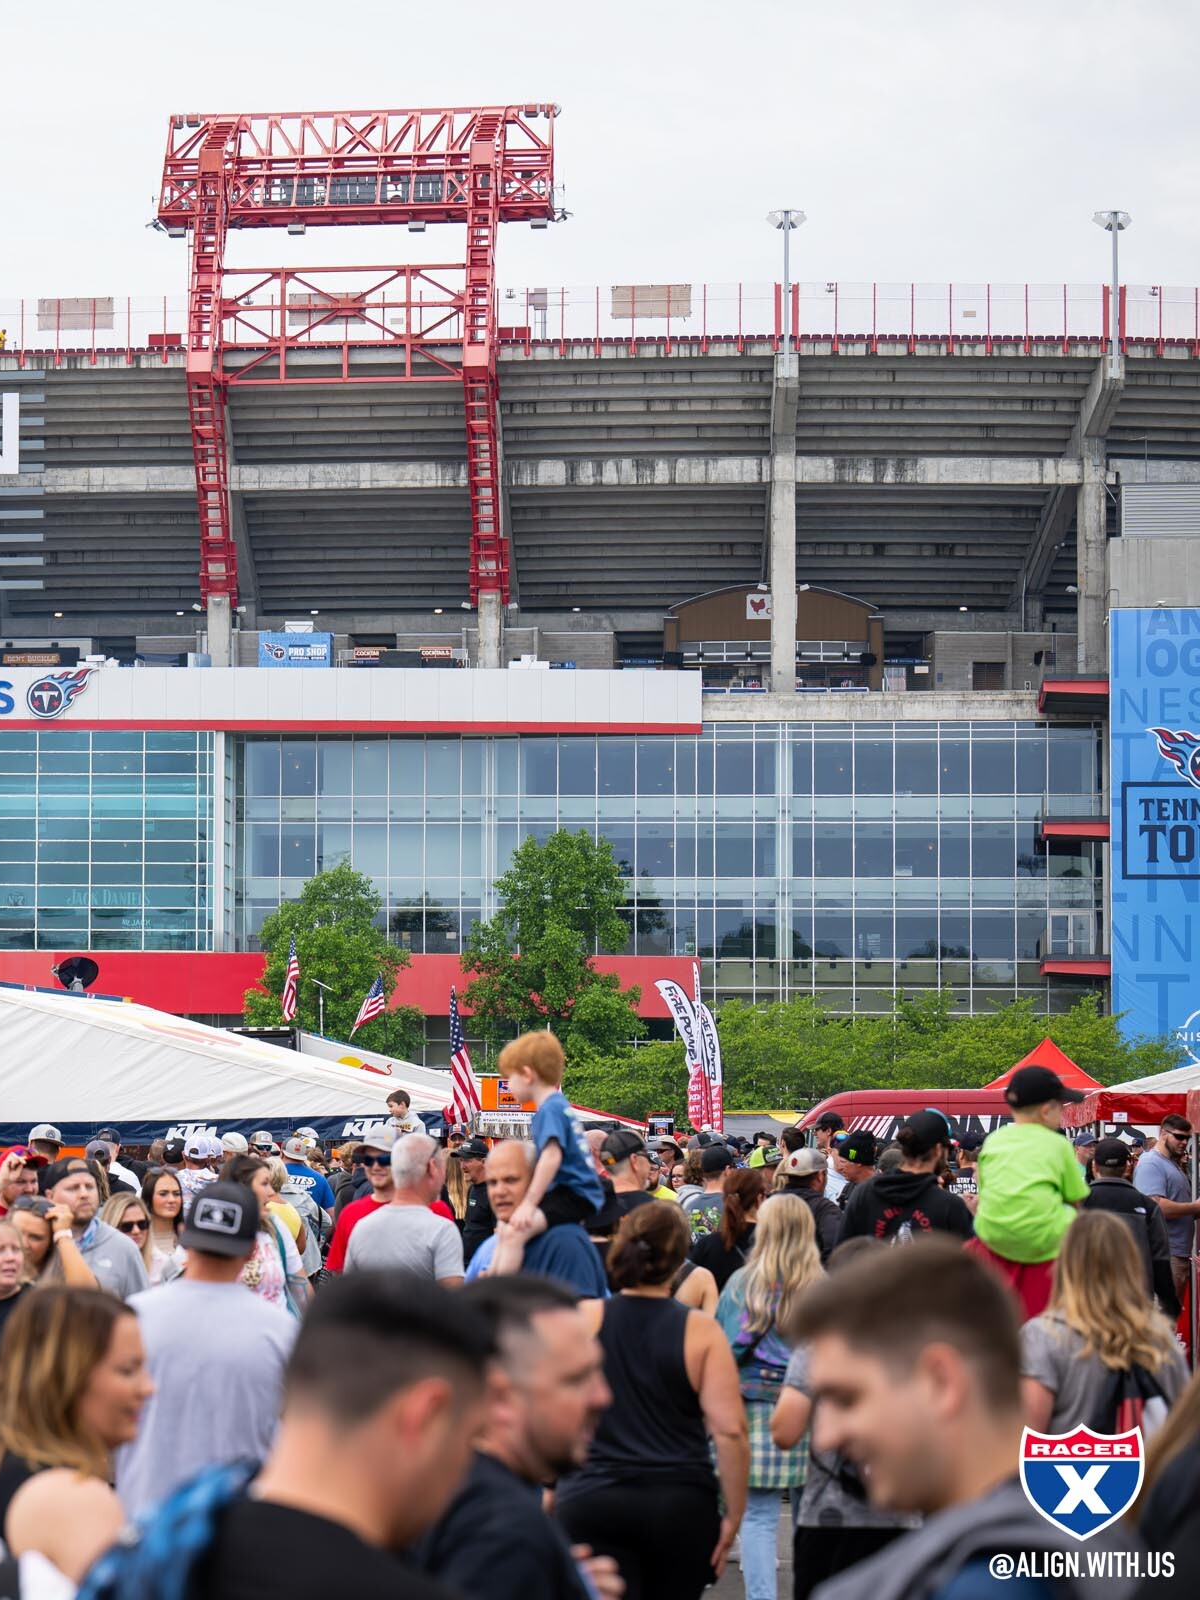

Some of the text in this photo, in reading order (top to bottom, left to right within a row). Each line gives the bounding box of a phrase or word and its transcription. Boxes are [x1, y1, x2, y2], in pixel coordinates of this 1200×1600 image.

[288, 648, 327, 656] PRO SHOP
[1139, 825, 1200, 863] TO
[665, 985, 688, 1015] FIRE
[679, 1016, 698, 1062] POWER
[165, 1122, 218, 1141] KTM
